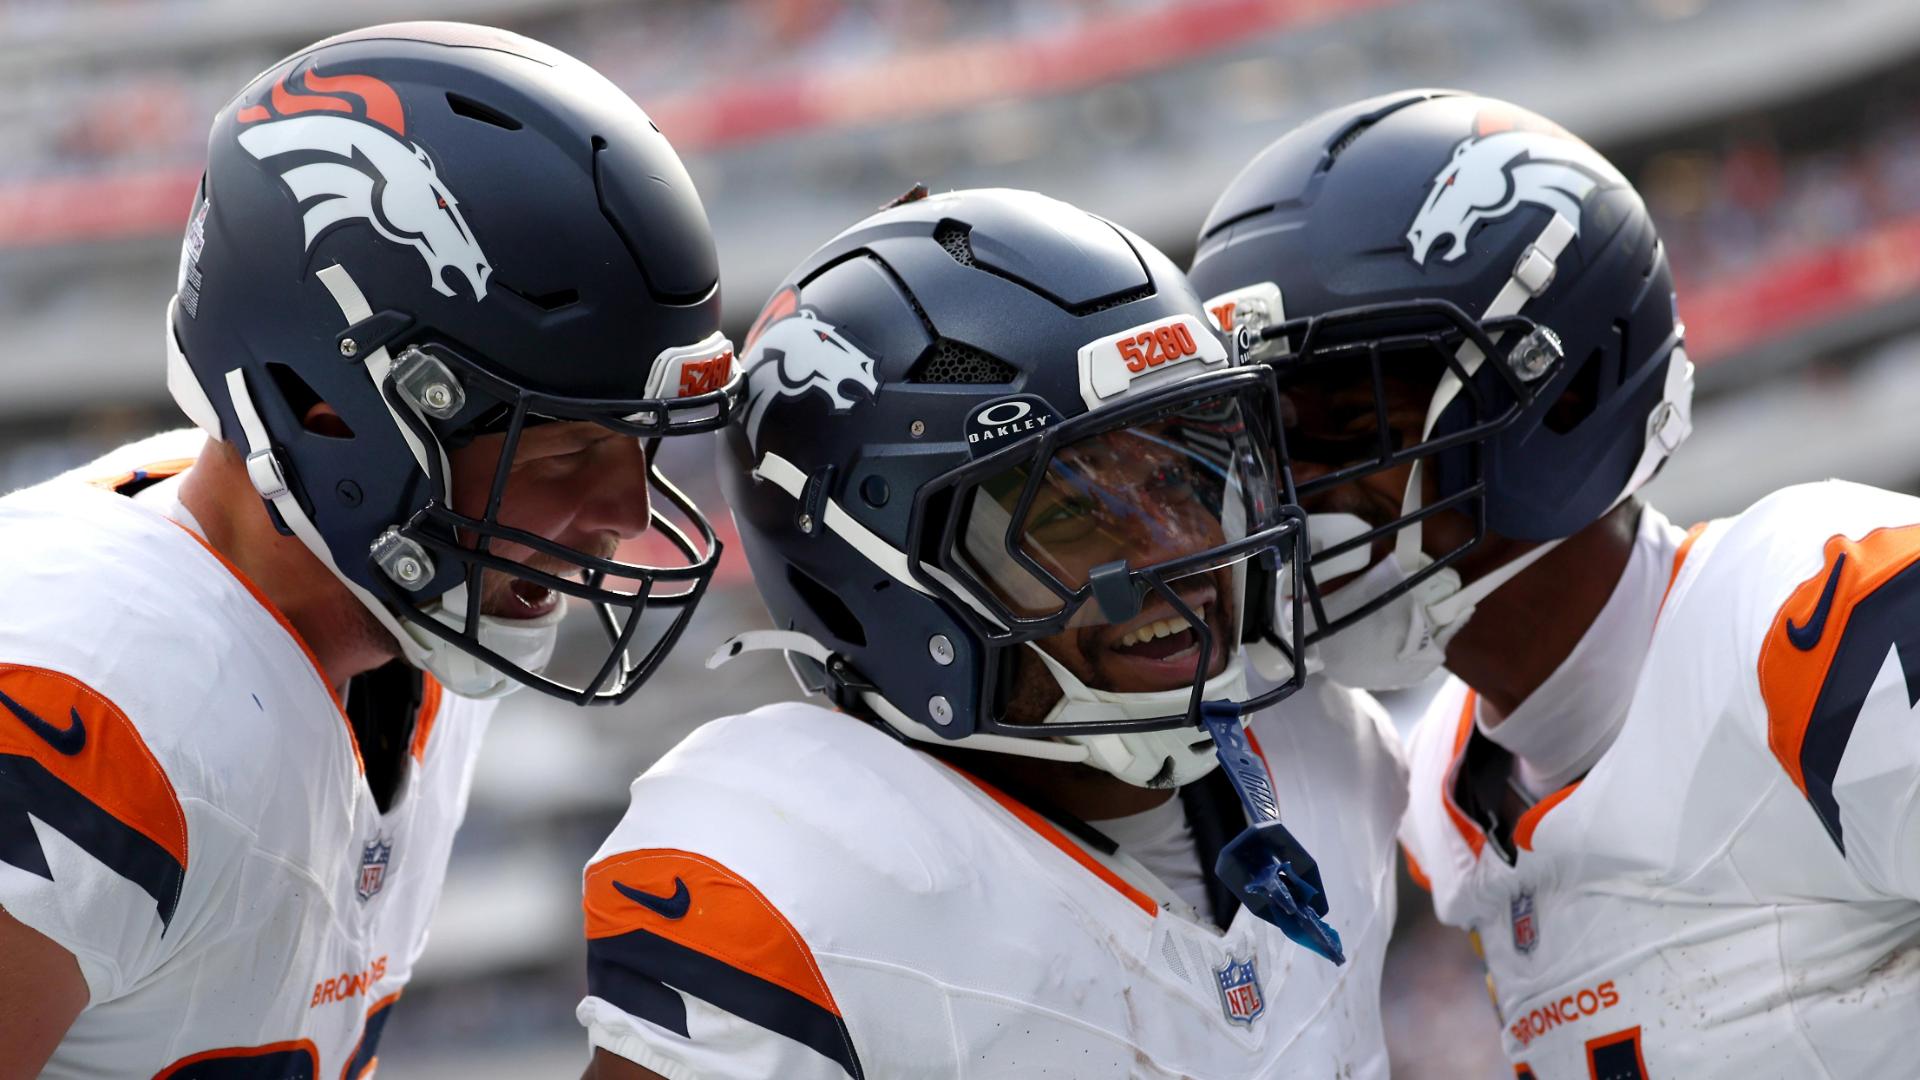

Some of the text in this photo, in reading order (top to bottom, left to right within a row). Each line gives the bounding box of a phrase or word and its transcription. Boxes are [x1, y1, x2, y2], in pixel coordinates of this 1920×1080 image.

[1116, 322, 1198, 374] 5280
[968, 415, 1047, 443] OAKLEY
[311, 955, 388, 1008] BRONS
[1227, 985, 1260, 1015] NFL
